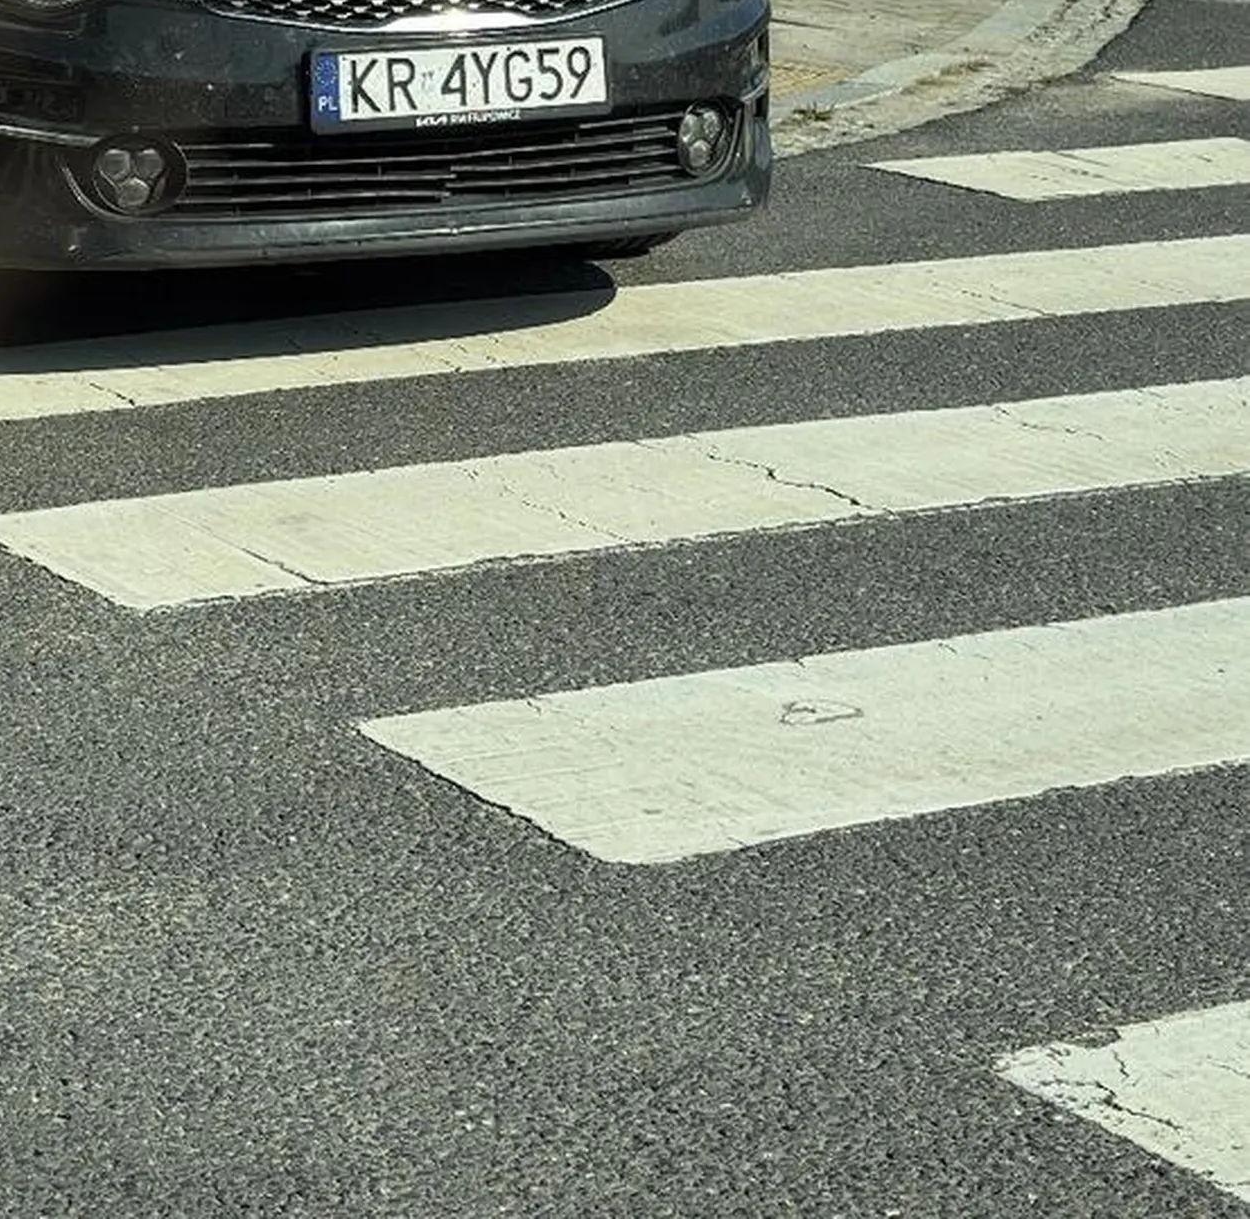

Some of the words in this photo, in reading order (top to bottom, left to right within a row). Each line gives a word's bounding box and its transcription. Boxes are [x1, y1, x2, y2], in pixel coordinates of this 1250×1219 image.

[351, 58, 417, 113] KR
[441, 46, 591, 107] 4YG59
[318, 95, 339, 112] PL
